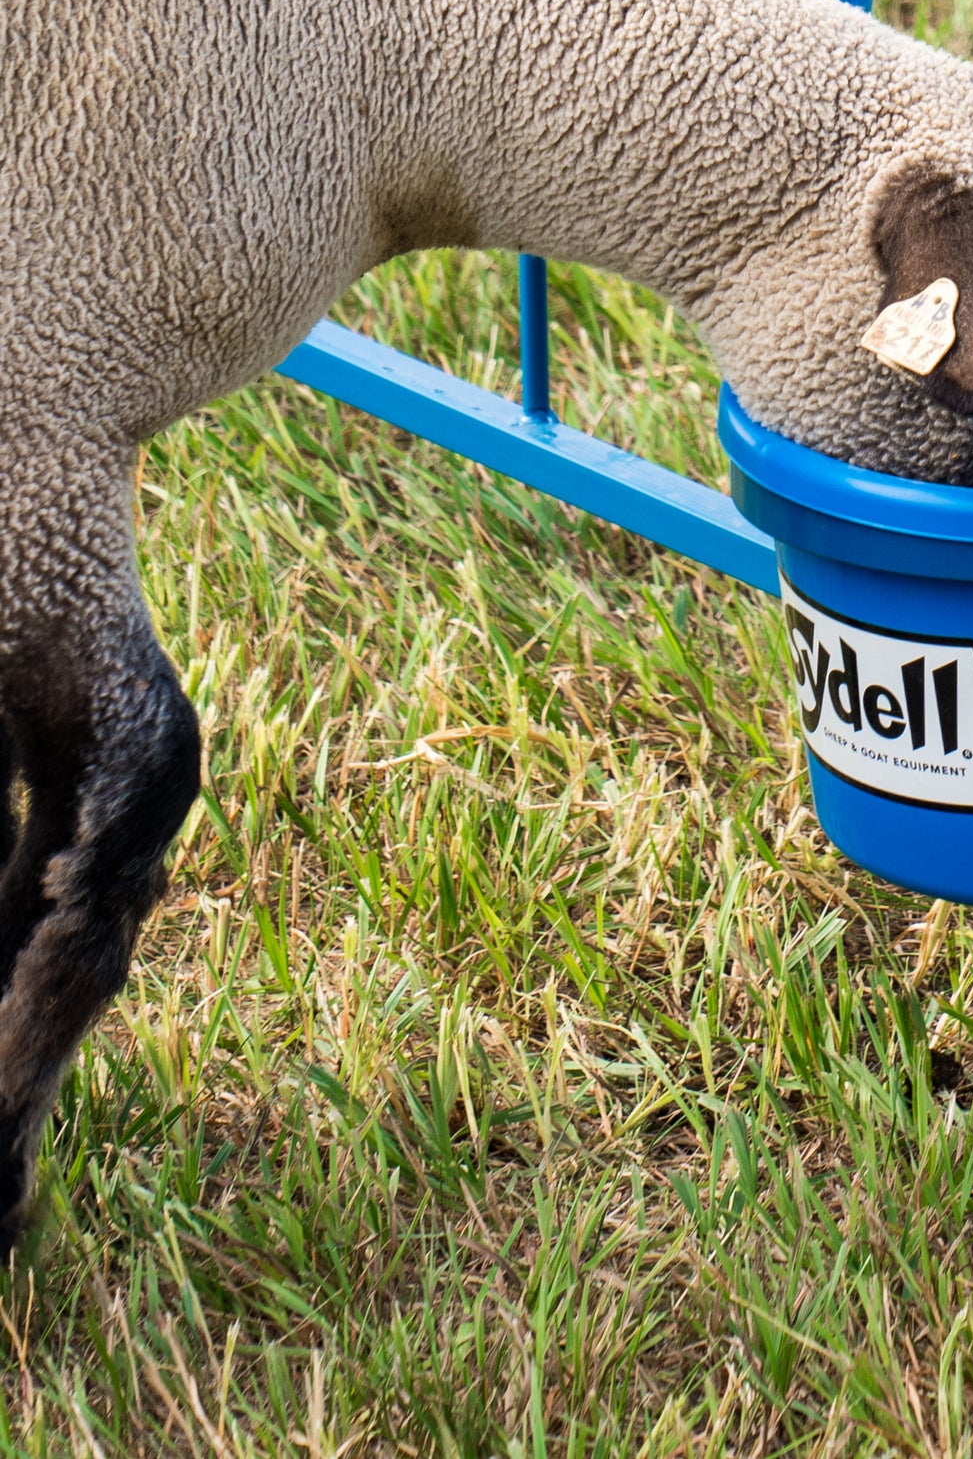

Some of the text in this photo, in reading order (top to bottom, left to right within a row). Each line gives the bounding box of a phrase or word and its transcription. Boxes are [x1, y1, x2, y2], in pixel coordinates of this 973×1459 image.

[785, 604, 958, 756] Sydell
[860, 746, 889, 764] GOAT
[893, 756, 967, 777] EQUIPMENT
